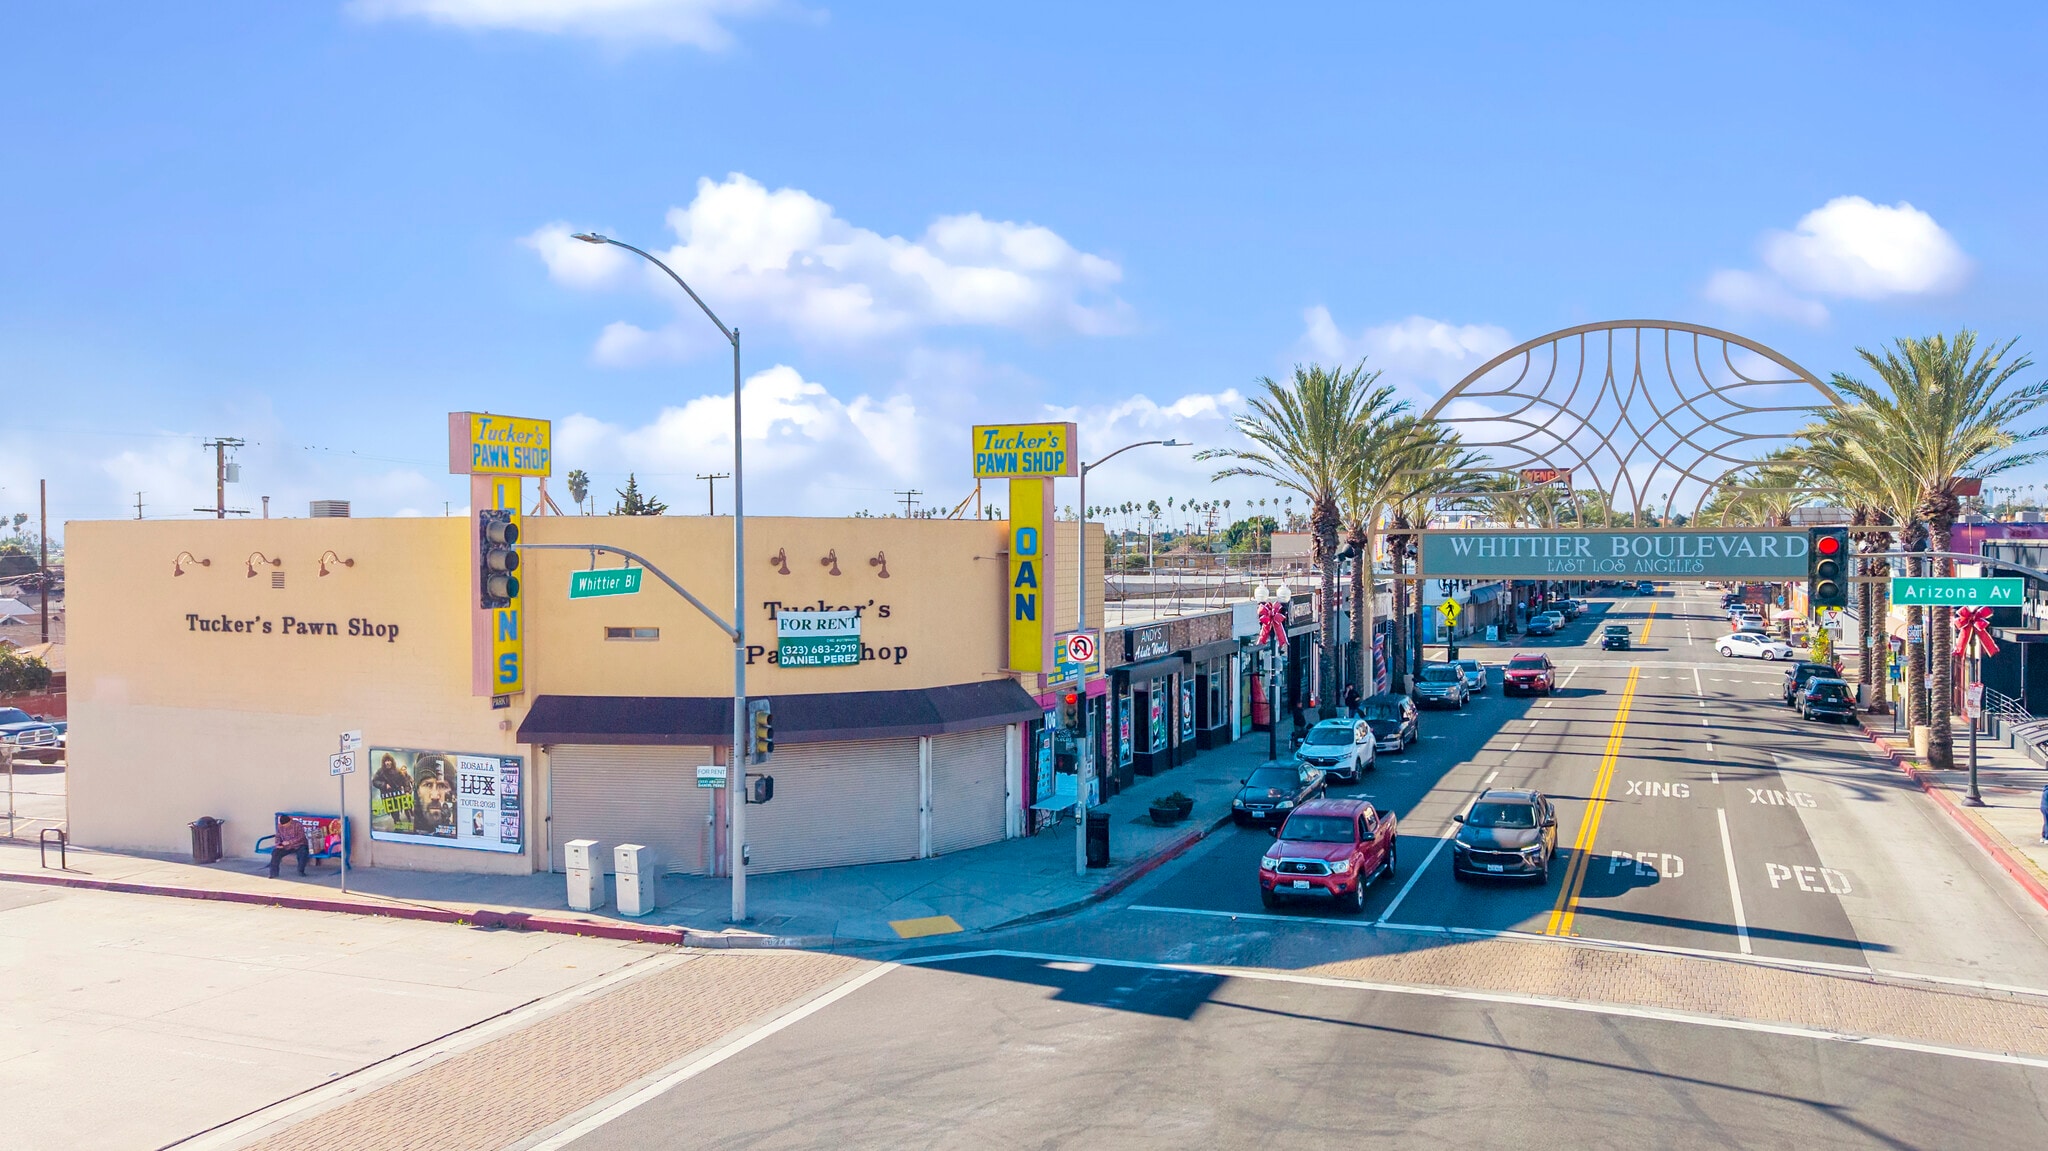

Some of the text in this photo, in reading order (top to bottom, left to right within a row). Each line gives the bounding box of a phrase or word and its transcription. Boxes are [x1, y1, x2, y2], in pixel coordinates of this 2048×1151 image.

[478, 417, 544, 445] Tucker's
[983, 429, 1060, 450] Tucker's
[473, 443, 549, 470] PAWN SHOP
[976, 451, 1065, 473] PAWN SHOP
[1451, 536, 1809, 558] WHITTIER BOULEVARD
[1547, 559, 1705, 573] EAST LOS ANGELES
[579, 574, 636, 591] Whittier Bl
[1904, 584, 2012, 599] Arizona Av
[186, 613, 399, 643] Tucker's Pawn Shop
[780, 616, 858, 631] FOR RENT
[781, 644, 857, 656] (323) 683-2919
[781, 653, 857, 666] DANIEL PEREZ
[860, 642, 908, 665] hop
[1625, 780, 1690, 798] XING
[1747, 787, 1818, 808] XING
[1608, 850, 1684, 878] PED
[1765, 862, 1853, 895] PED
